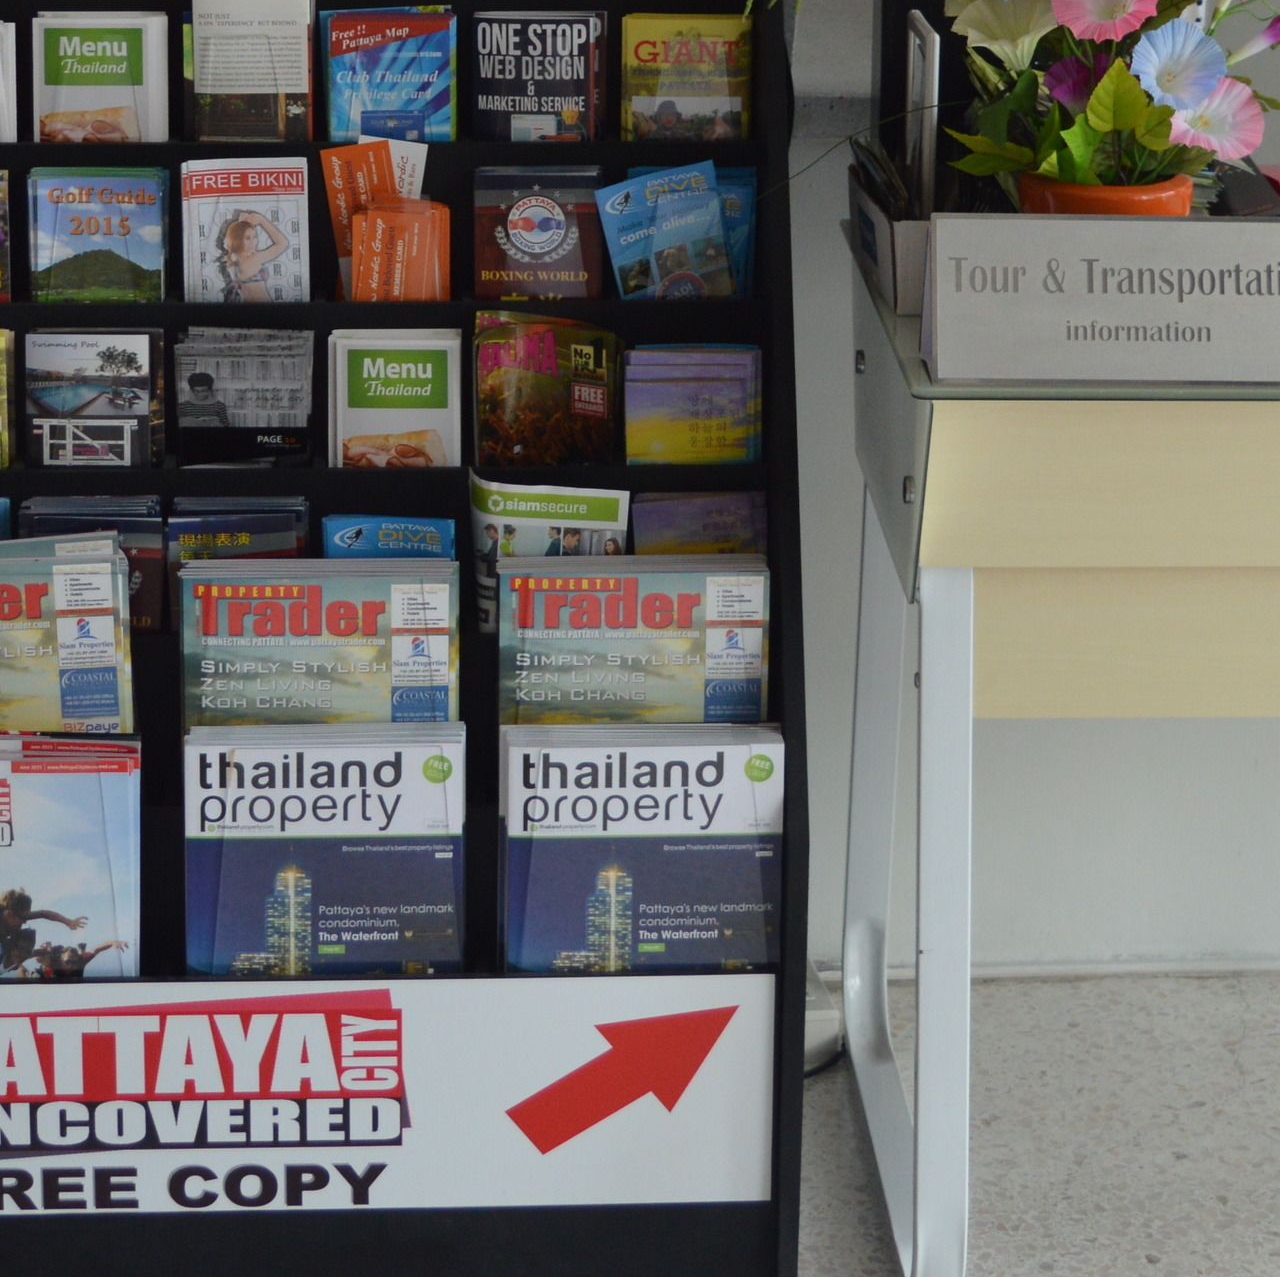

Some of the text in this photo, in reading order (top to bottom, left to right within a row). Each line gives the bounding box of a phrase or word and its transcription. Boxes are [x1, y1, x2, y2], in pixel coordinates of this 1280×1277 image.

[331, 29, 355, 41] Free
[342, 27, 409, 50] Pattaya Map
[477, 22, 587, 57] ONE STOP
[58, 36, 128, 57] Menu
[634, 39, 744, 65] GIANT
[61, 58, 127, 75] Thailand
[479, 55, 585, 80] WEB DESIGN
[336, 70, 439, 83] Club Thailand
[478, 94, 586, 112] MARKETING SERVICE
[192, 171, 303, 191] FREE BIKINI
[47, 187, 157, 205] Golf Guide
[69, 216, 131, 237] 2015
[619, 228, 657, 246] come
[480, 269, 588, 282] BOXING WORLD
[947, 256, 1026, 294] Tour
[1041, 257, 1067, 295] &
[1065, 319, 1213, 344] information
[362, 357, 433, 379] Menu
[365, 379, 432, 398] Thailand
[574, 385, 604, 404] FREE
[257, 434, 282, 443] PAGE
[505, 498, 588, 514] siamsecure
[377, 530, 442, 545] DIVE
[197, 585, 301, 598] PROPERTY
[514, 578, 617, 591] PROPERTY
[198, 584, 387, 638] Trader
[516, 577, 702, 630] Trader
[200, 660, 387, 674] SIMPLY STYLISH
[200, 677, 333, 692] ZEN LIVING
[200, 695, 333, 709] KOH CHANG
[199, 751, 404, 790] thailand
[521, 750, 726, 790] thailand
[199, 787, 403, 833] property
[522, 787, 725, 832] property
[318, 903, 454, 917] Pattaya's new landmark
[318, 931, 399, 941] The Waterfront
[339, 1013, 400, 1092] CITY
[167, 1162, 389, 1208] COPY
